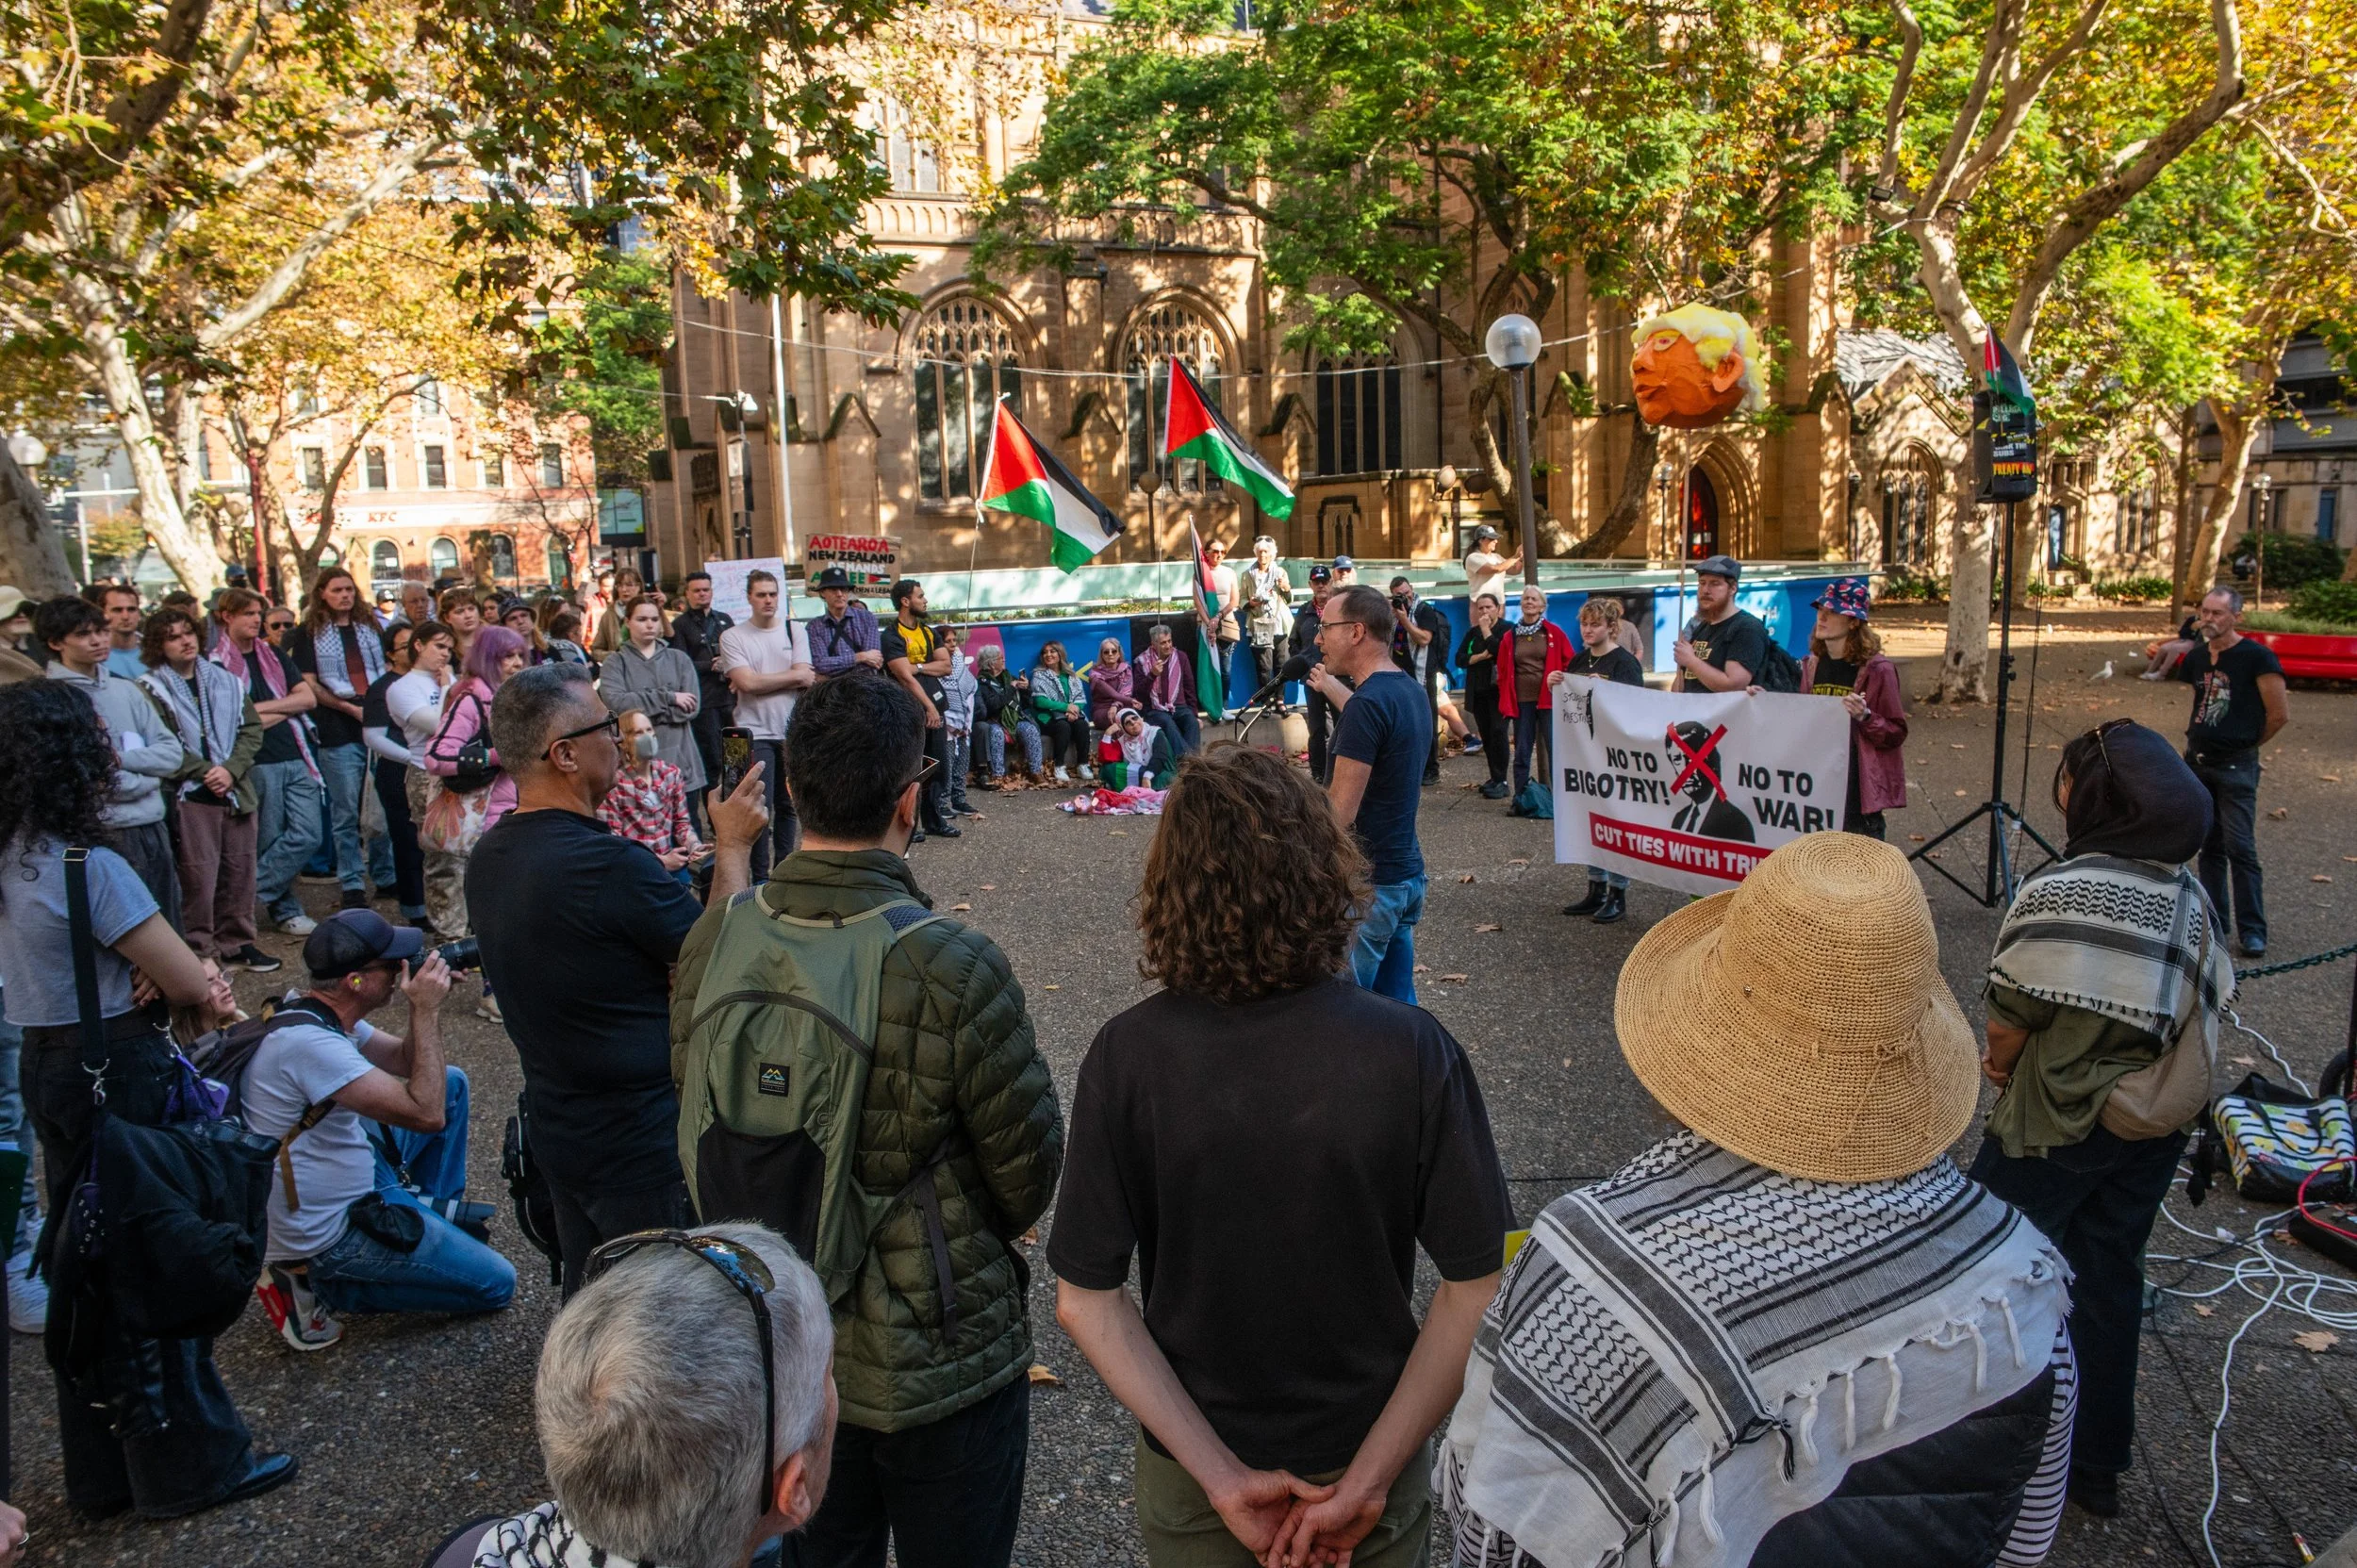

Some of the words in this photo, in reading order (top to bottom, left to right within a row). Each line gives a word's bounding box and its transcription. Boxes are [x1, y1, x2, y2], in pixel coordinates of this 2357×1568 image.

[368, 512, 397, 522] KFC
[809, 551, 835, 560] NEW
[838, 552, 896, 564] ZEALAND
[810, 536, 889, 553] AOTEAROA
[1606, 746, 1629, 770] NO
[1630, 751, 1657, 773] TO
[1564, 767, 1671, 806] BIGOTRY!
[1739, 763, 1771, 790] NO
[1777, 769, 1813, 798] TO
[1753, 796, 1835, 834] WAR!
[1594, 822, 1623, 846] CUT
[1624, 831, 1665, 859] TIES
[1668, 840, 1721, 870] WITH
